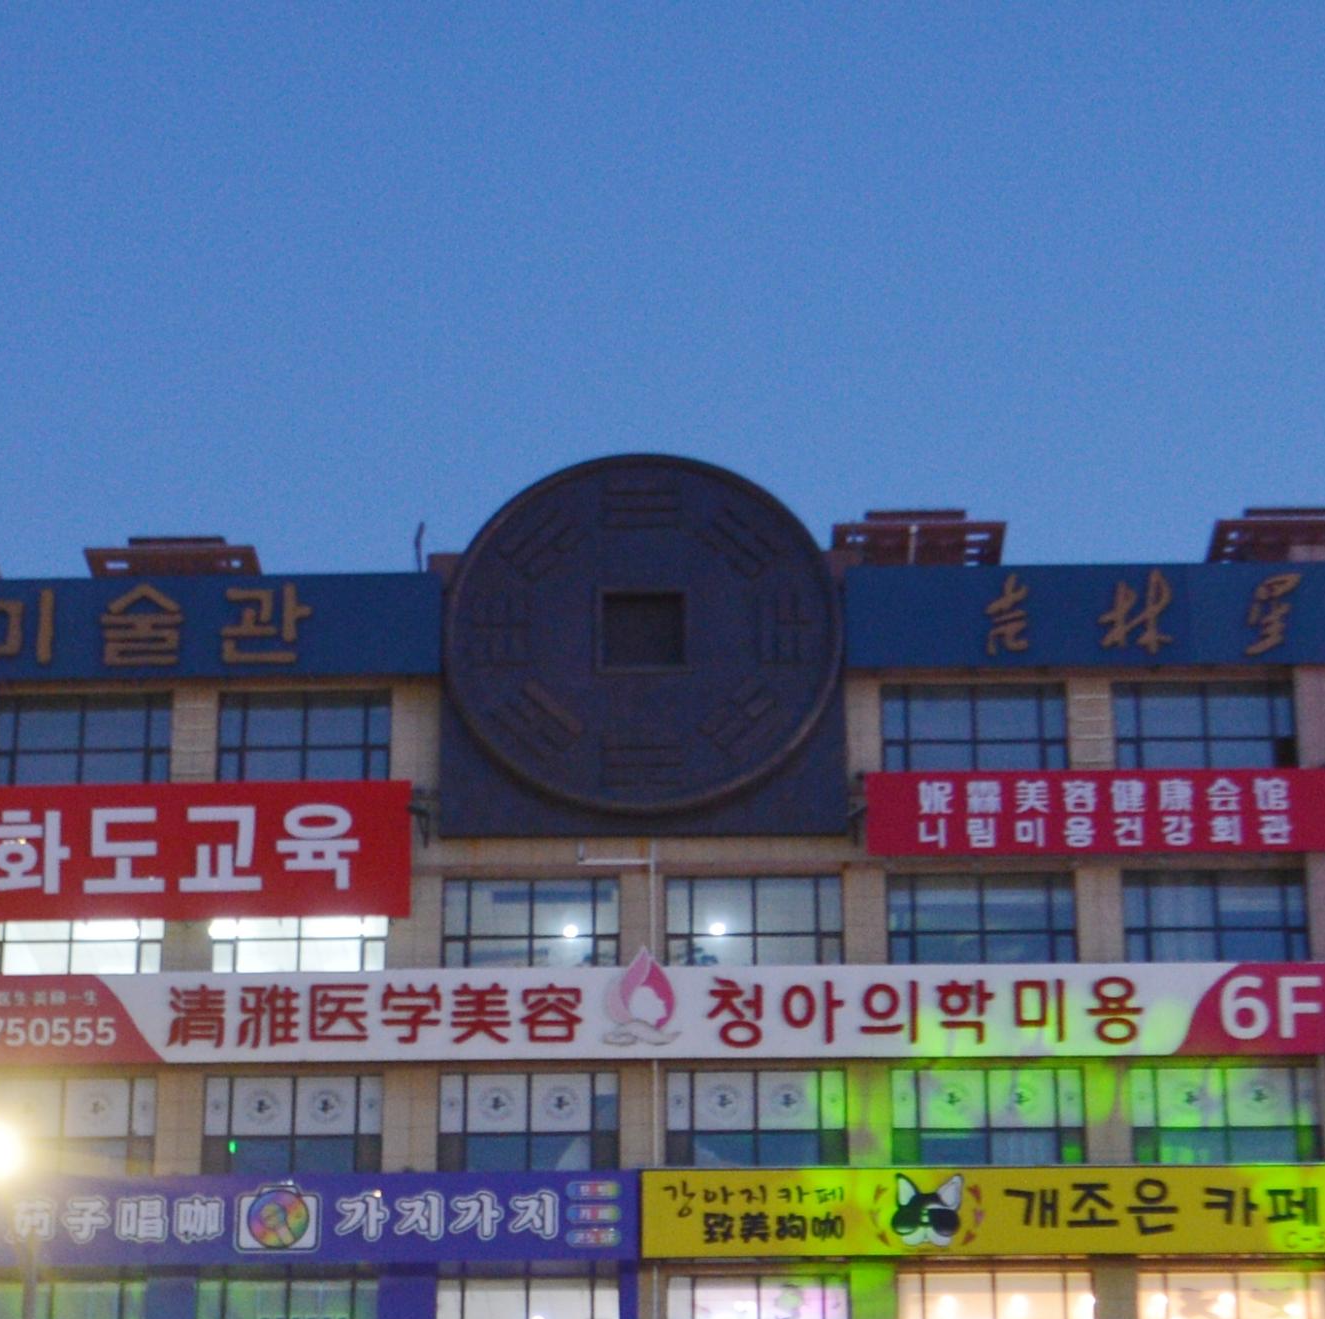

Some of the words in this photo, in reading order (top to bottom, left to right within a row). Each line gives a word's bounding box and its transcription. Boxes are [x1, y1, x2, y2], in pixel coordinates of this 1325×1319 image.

[167, 983, 584, 1049] 清雅医学美容
[706, 976, 1145, 1048] 청아의학미용
[1219, 975, 1322, 1039] 6F
[334, 1194, 562, 1242] 가지가지
